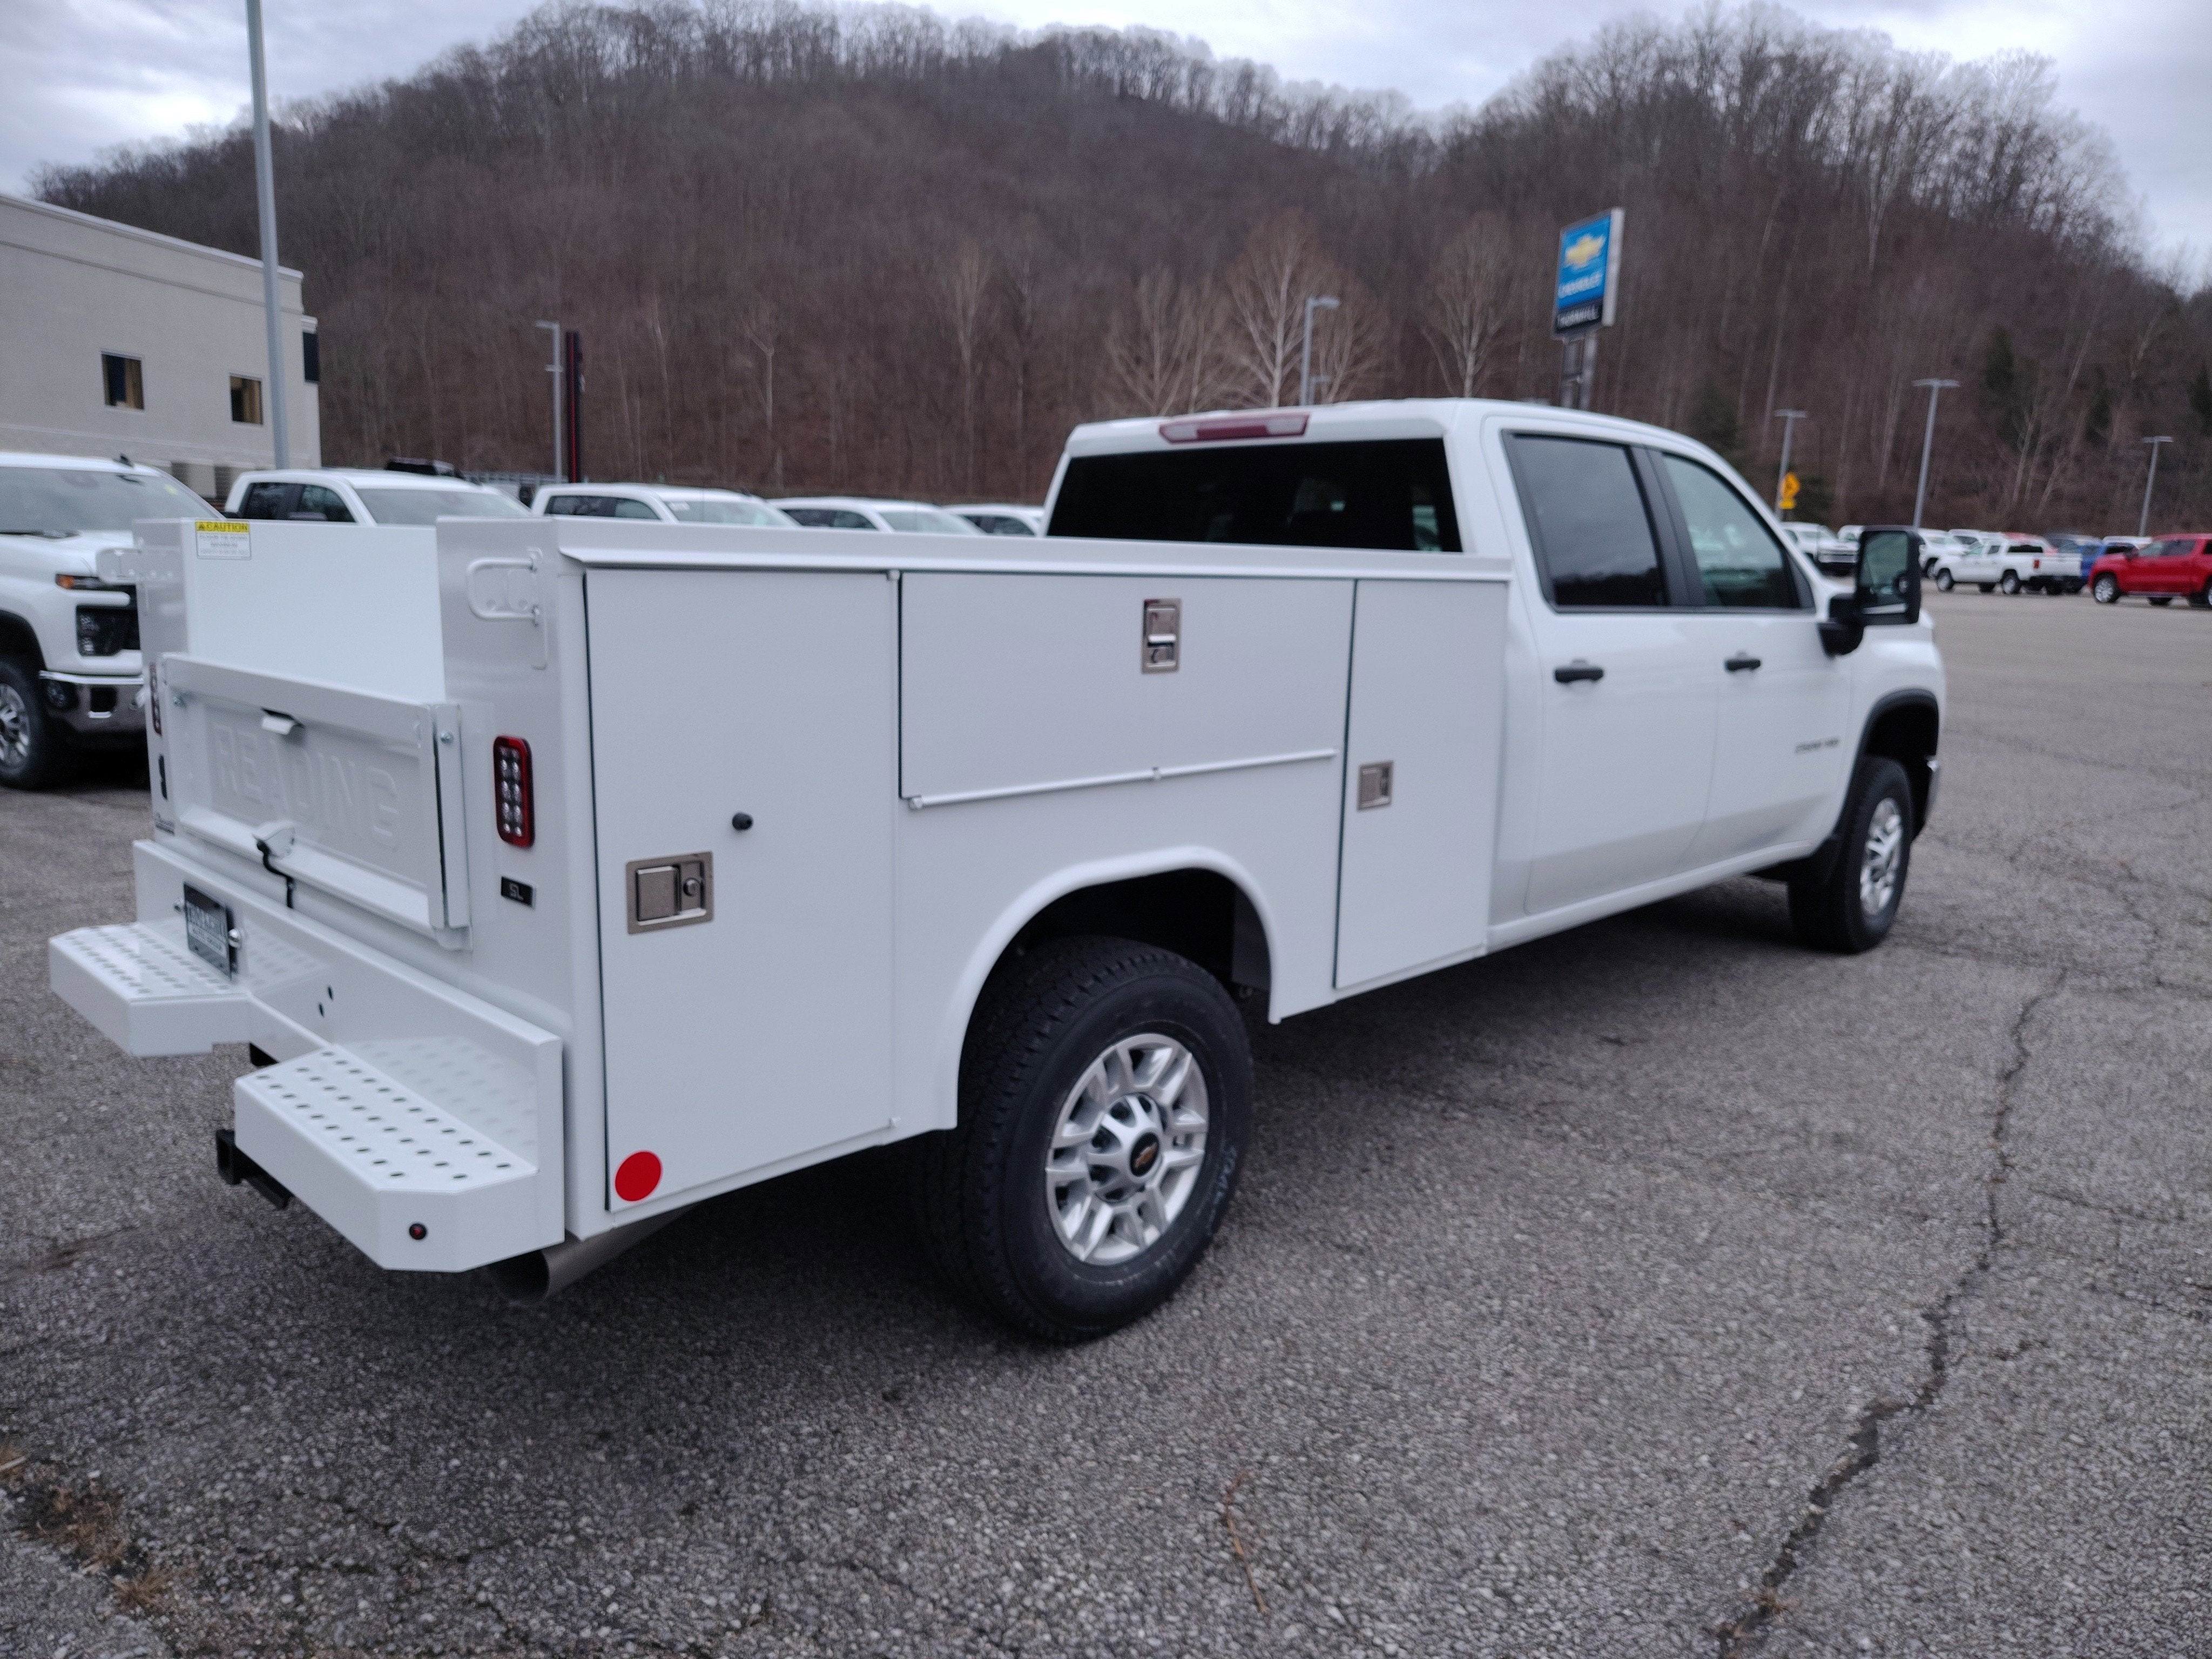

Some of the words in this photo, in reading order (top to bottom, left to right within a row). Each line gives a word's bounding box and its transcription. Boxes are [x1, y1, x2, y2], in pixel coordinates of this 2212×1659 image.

[206, 522, 248, 532] CAUTION
[212, 721, 400, 845] READING
[509, 882, 524, 901] SL
